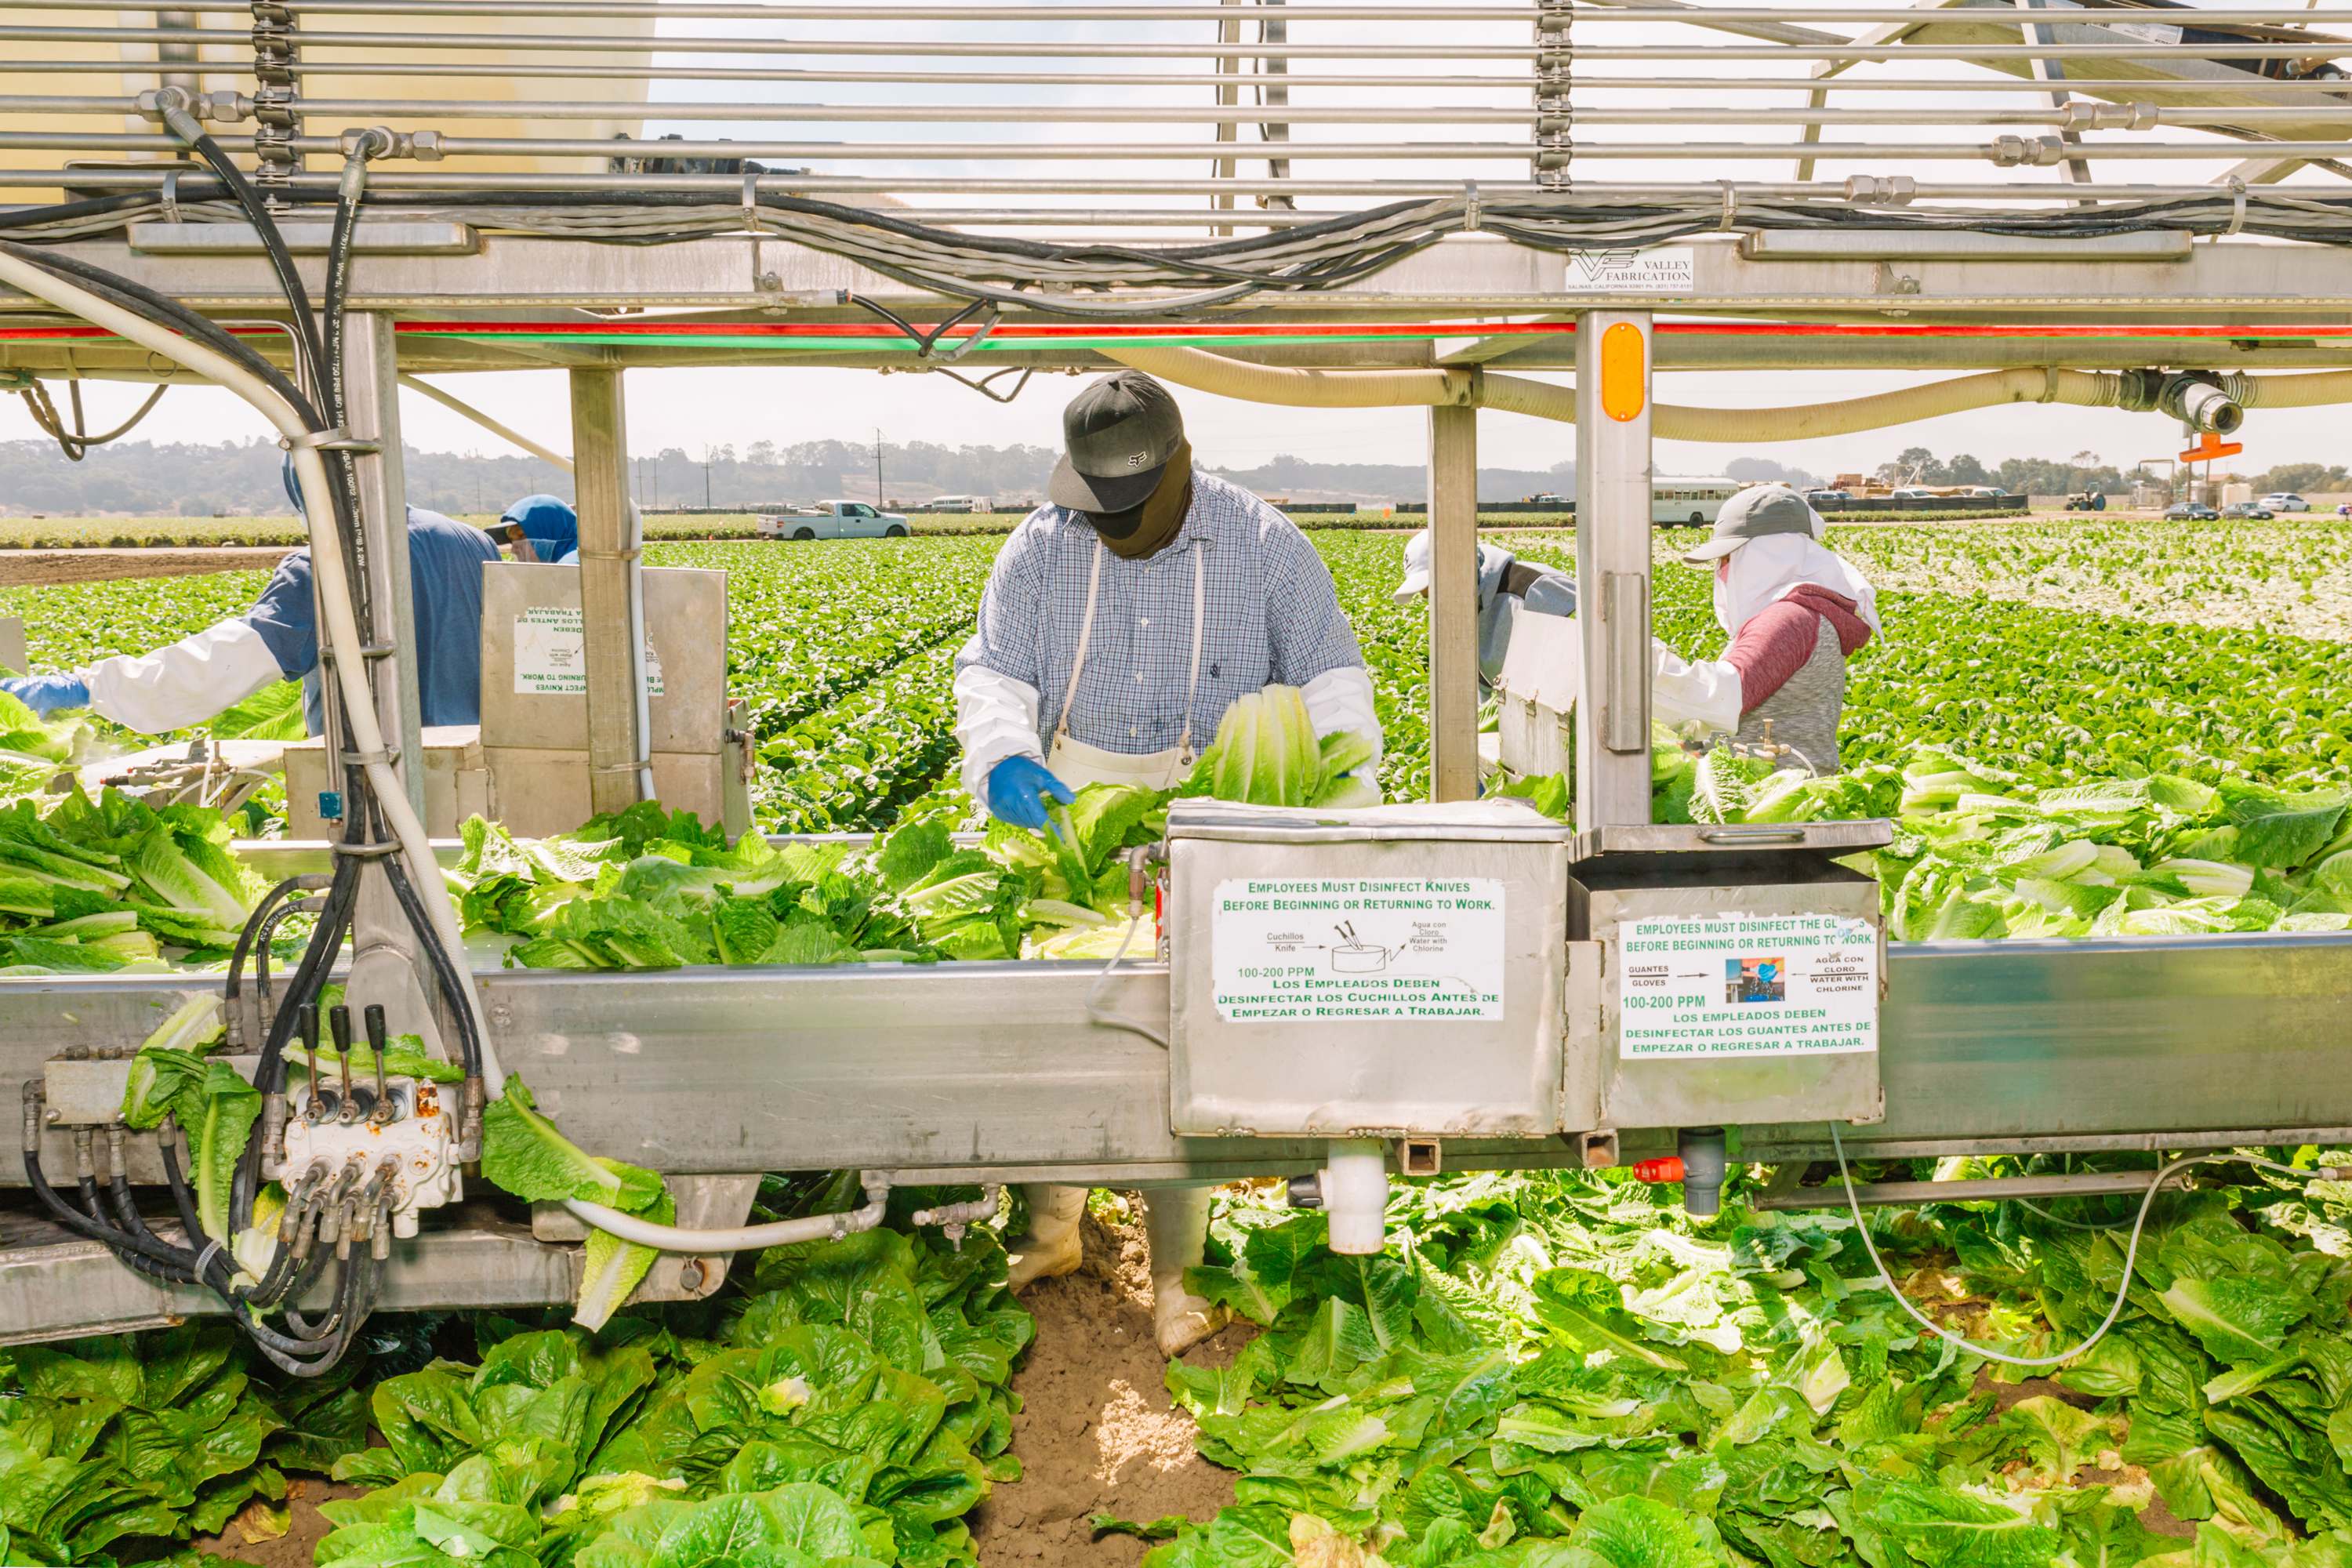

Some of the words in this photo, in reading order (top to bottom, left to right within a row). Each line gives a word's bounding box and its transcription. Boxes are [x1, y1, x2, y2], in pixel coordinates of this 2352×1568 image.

[1645, 261, 1690, 270] VALLEY
[1606, 272, 1690, 281] FABRICATION
[357, 554, 365, 567] 2W
[1248, 882, 1318, 893] EMPLOYEES
[1321, 881, 1356, 892] MUST
[1359, 881, 1421, 892] DISINFECT
[1425, 881, 1470, 892] KNIVES
[1223, 899, 1269, 911] BEFORE
[1273, 899, 1340, 910] BEGINNING
[1343, 900, 1359, 910] OR
[1363, 898, 1433, 910] RETURNING
[1436, 899, 1451, 909] TO
[1455, 899, 1495, 910] WORK.
[1636, 924, 1701, 935] EMPLOYEES
[1704, 923, 1736, 933] MUST
[1739, 920, 1796, 932] DISINFECT
[1799, 919, 1820, 930] THE
[1824, 918, 1865, 929] GLS
[1626, 941, 1668, 952] BEFORE
[1672, 938, 1734, 950] BEGINNING
[1738, 938, 1754, 949] OR
[1757, 936, 1820, 947] RETURNING
[1237, 968, 1284, 978] 100-200
[1287, 967, 1315, 977] PPM
[1628, 965, 1668, 974] GUANTES
[1272, 979, 1301, 989] LOS
[1305, 979, 1388, 988] EMPLEADOS
[1393, 978, 1440, 988] DEBEN
[1218, 993, 1312, 1004] DESINFECTAR
[1317, 993, 1343, 1003] LOS
[1348, 993, 1426, 1002] CUCHILLOS
[1431, 993, 1477, 1002] ANTES
[1481, 993, 1499, 1002] DE
[1624, 996, 1674, 1008] 100-200
[1678, 996, 1705, 1007] PPM
[1232, 1007, 1298, 1017] EMPEZAR
[1316, 1007, 1390, 1016] REGRESAR
[1408, 1006, 1484, 1016] TRABAJAR.
[1673, 1013, 1697, 1022] LOS
[1703, 1011, 1781, 1022] EMPLEADOS
[1784, 1009, 1826, 1018] DEBEN
[1625, 1027, 1714, 1038] DESINFECTAR
[1719, 1026, 1743, 1036] LOS
[1748, 1025, 1807, 1036] GUANTES
[1812, 1023, 1852, 1033] ANTES
[1856, 1022, 1871, 1030] DE
[1633, 1042, 1693, 1053] EMPEZAR
[1697, 1042, 1706, 1051] O
[1711, 1040, 1780, 1051] REGRESAR
[1784, 1040, 1792, 1049] A
[1796, 1037, 1864, 1048] TRABAJAR.
